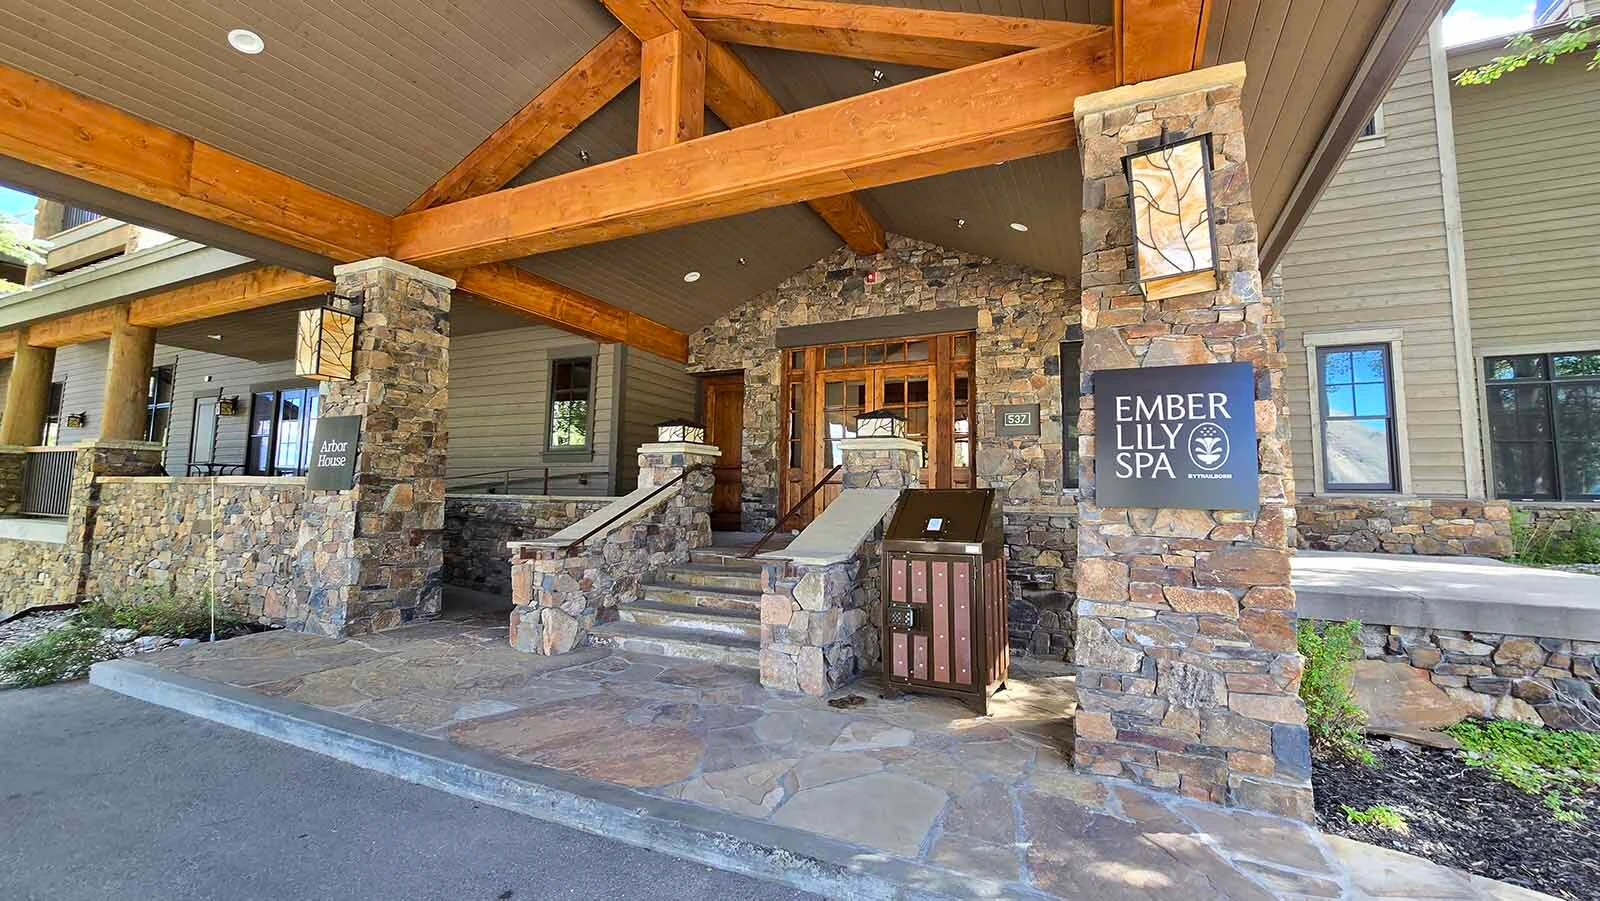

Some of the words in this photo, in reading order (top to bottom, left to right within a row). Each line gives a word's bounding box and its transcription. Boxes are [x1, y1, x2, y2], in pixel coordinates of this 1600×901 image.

[1115, 393, 1232, 421] EMBER
[1007, 414, 1027, 424] 537
[320, 439, 348, 453] Arbor
[1115, 423, 1184, 450] LILY
[318, 454, 346, 467] House
[1115, 452, 1176, 479] SPA
